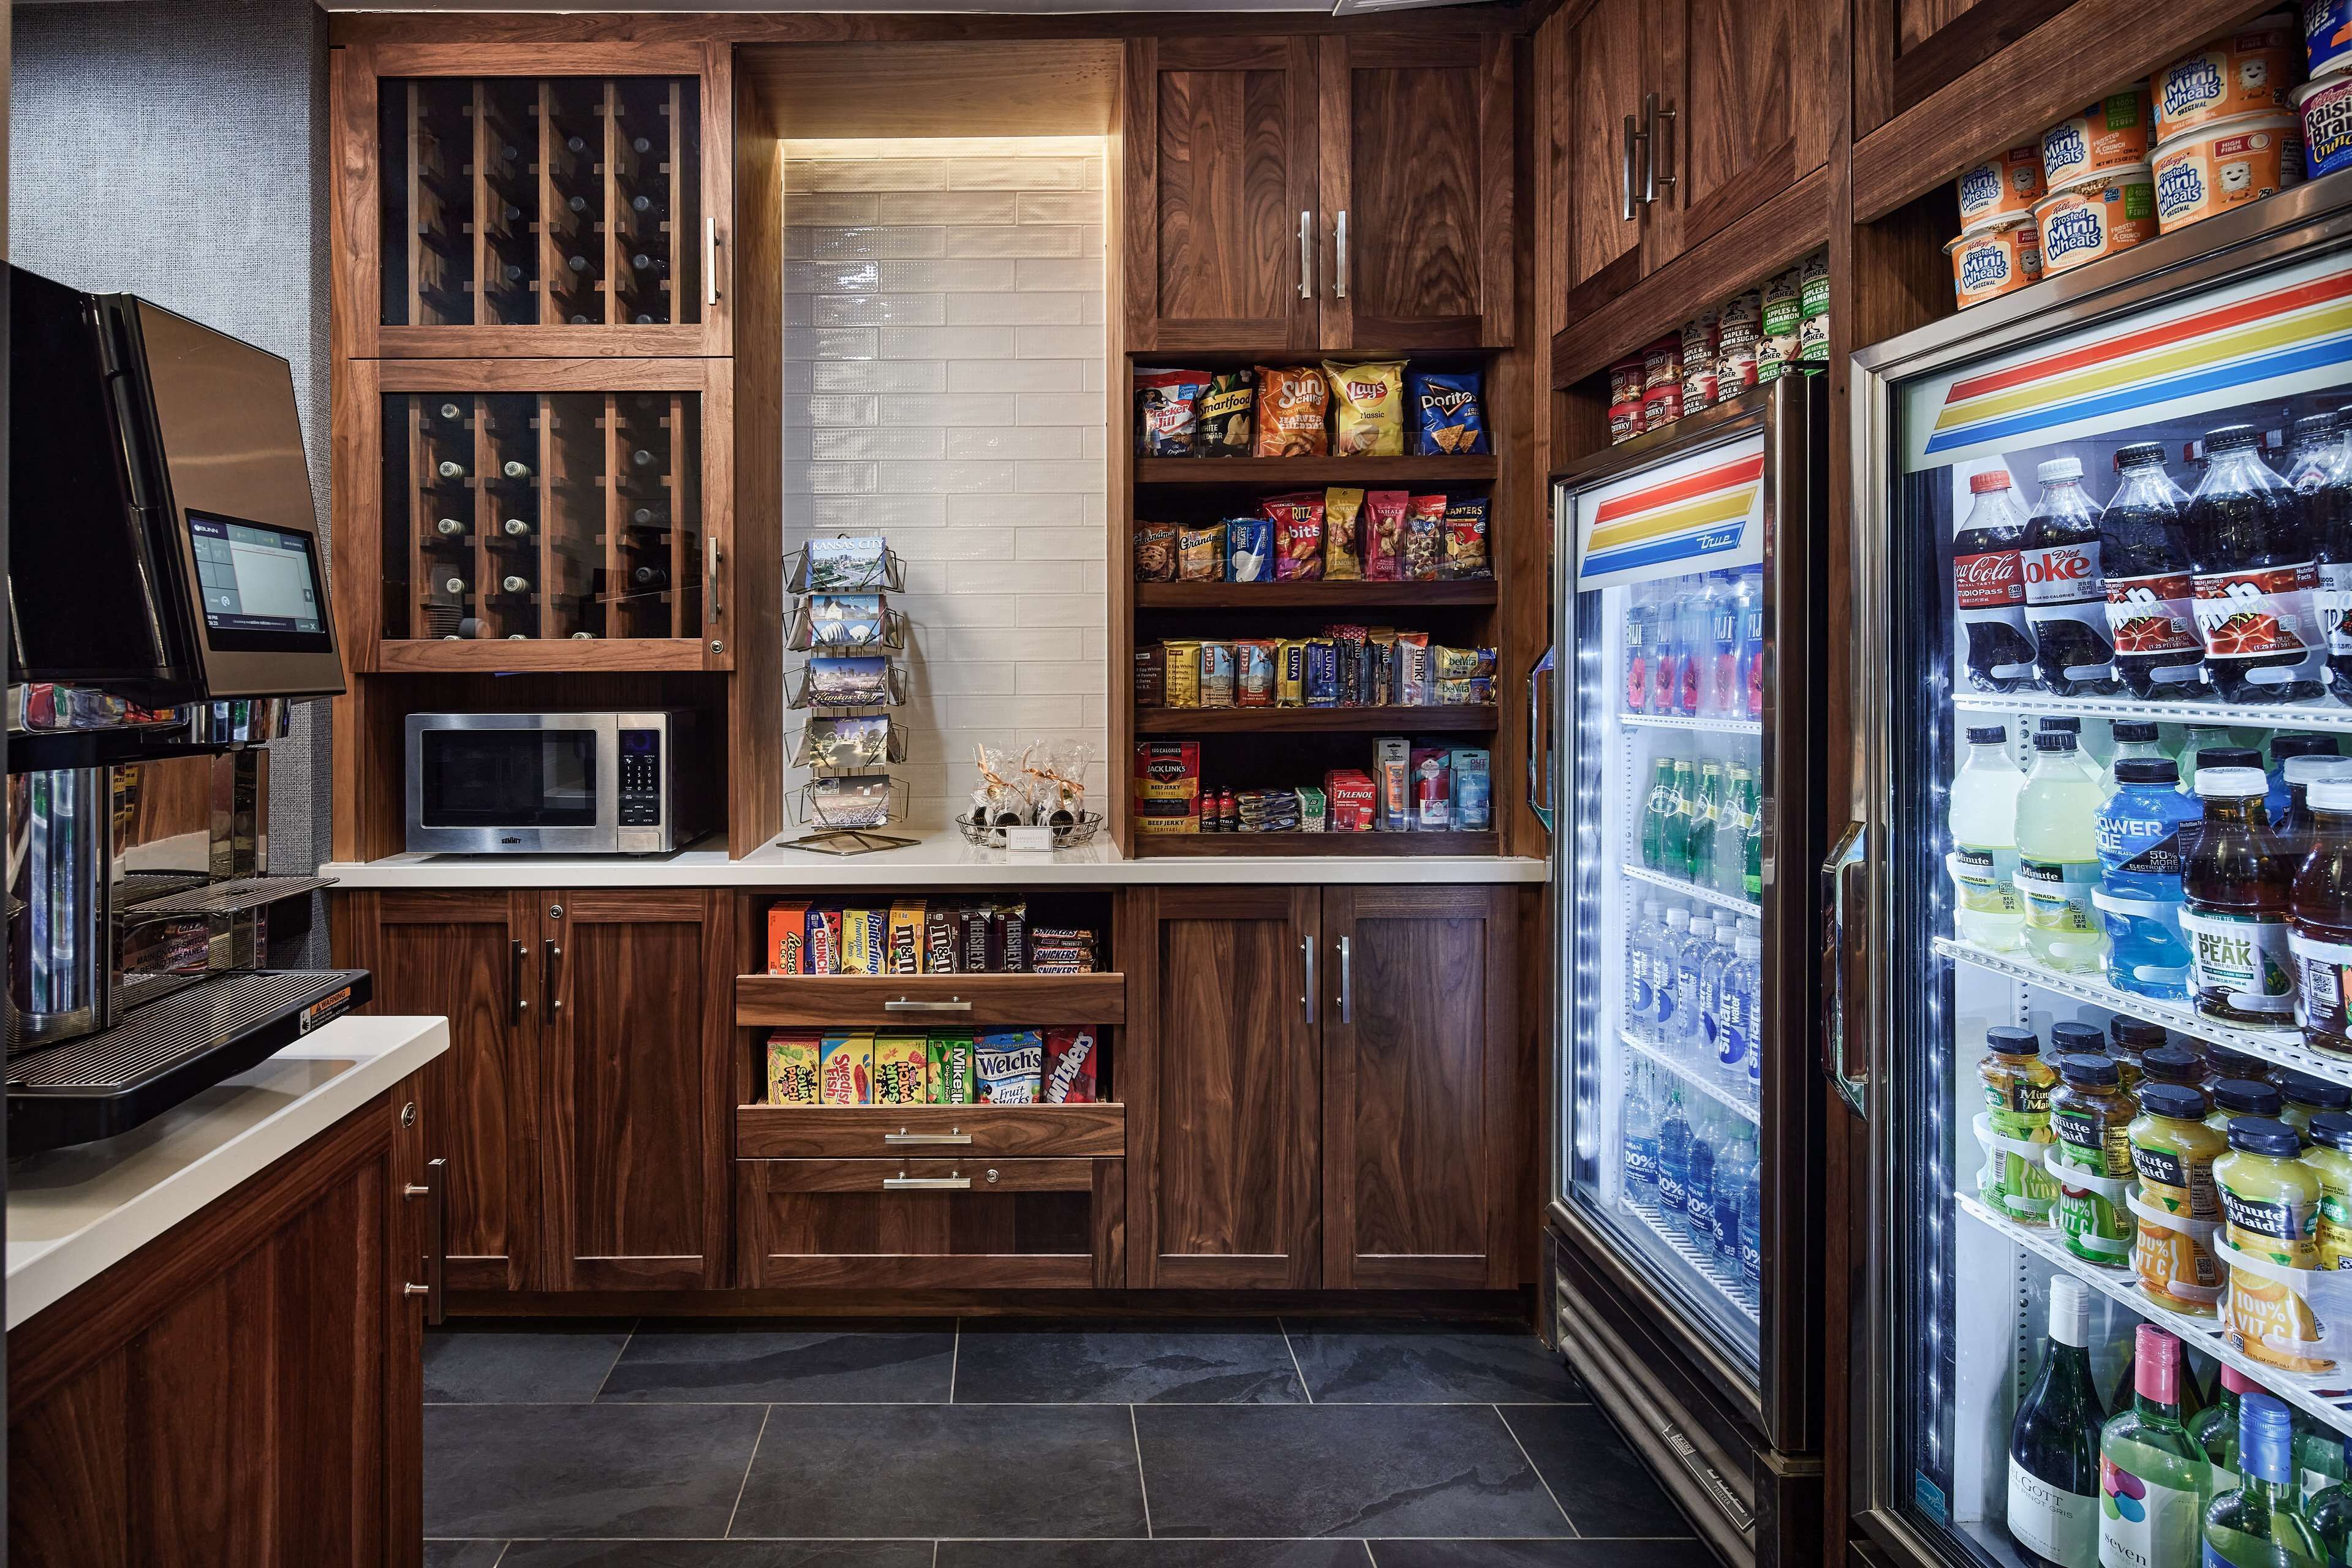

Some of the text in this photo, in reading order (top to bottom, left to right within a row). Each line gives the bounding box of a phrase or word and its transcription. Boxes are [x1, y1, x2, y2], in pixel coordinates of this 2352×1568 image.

[2167, 66, 2215, 100] Mini
[2165, 83, 2218, 113] Wheats
[2177, 100, 2207, 116] ORIGINAL
[2111, 118, 2134, 127] FIBER
[2093, 132, 2120, 147] FROSTED
[2159, 153, 2187, 171] Kellogg's
[2160, 164, 2187, 184] Frosted
[2081, 183, 2104, 193] PULL
[2158, 171, 2196, 201] Mini
[2053, 198, 2087, 214] Kellogg's
[2159, 187, 2200, 216] Wheats
[2166, 204, 2190, 218] ORIGINAL
[2053, 209, 2086, 228] Frosted
[2111, 222, 2136, 233] FROSTED
[2049, 216, 2095, 244] Mini
[1967, 246, 1994, 262] Frosted
[2049, 232, 2098, 259] Wheats
[1973, 280, 1995, 290] ORIGINAL
[1766, 289, 1796, 303] QUAKER
[1722, 314, 1749, 325] QUAKER
[1766, 313, 1800, 326] CINNAMON
[1767, 307, 1790, 318] APPLES
[1723, 330, 1743, 339] MAPLE
[1692, 351, 1712, 361] SUGAR
[1758, 353, 1781, 364] QUAKER
[1278, 379, 1325, 409] Sun
[1295, 394, 1322, 405] CHIPS
[1347, 382, 1386, 400] Lay's
[1145, 404, 1189, 418] Cracker
[1199, 393, 1250, 418] Smartfood
[1152, 417, 1175, 429] Jill
[1611, 422, 1630, 433] CHUNKY
[1292, 507, 1312, 520] RITZ
[1289, 526, 1320, 538] bits
[813, 540, 883, 551] KANSAS CITY
[2052, 549, 2080, 560] Diet
[1628, 624, 1643, 645] FIJI
[1415, 649, 1426, 681] think!
[1449, 654, 1476, 666] belVita
[1443, 680, 1469, 693] belVita
[1337, 790, 1372, 799] TYLENOL
[1956, 852, 1989, 865] Minute
[2150, 851, 2177, 859] 50%
[2022, 866, 2059, 881] Minute
[855, 918, 864, 959] Unwrapped
[970, 921, 985, 970] HERSHEY'S
[1007, 921, 1022, 970] HERSHEY'S
[137, 935, 206, 965] MAIN SWITCH
[814, 930, 828, 974] CRUNCH
[827, 935, 837, 970] Buncha
[1035, 950, 1078, 960] SNICKERS
[2199, 941, 2253, 966] PEAK
[140, 954, 182, 974] BEHIND THIS
[320, 991, 345, 1008] WARNING
[1731, 996, 1741, 1023] water
[1720, 995, 1731, 1055] smart
[953, 1048, 966, 1088] Mike
[980, 1051, 1042, 1076] Welch's
[786, 1066, 800, 1101] PATCH
[797, 1067, 809, 1098] SOUR
[825, 1067, 840, 1098] Fish
[834, 1054, 851, 1104] Swedish
[887, 1065, 899, 1102] SOUR
[899, 1061, 913, 1104] PATCH
[1000, 1085, 1026, 1099] Fruit
[2222, 1192, 2286, 1222] Minute
[2228, 1210, 2277, 1235] Maid
[2157, 1257, 2166, 1276] C
[2236, 1291, 2287, 1323] 100%
[2237, 1312, 2266, 1340] VIT
[2233, 1334, 2242, 1344] 170
[1713, 1485, 1731, 1506] FREEZER
[2022, 1476, 2063, 1506] GOTT
[2021, 1488, 2074, 1518] PINOT GRIS
[2104, 1532, 2147, 1566] seven
